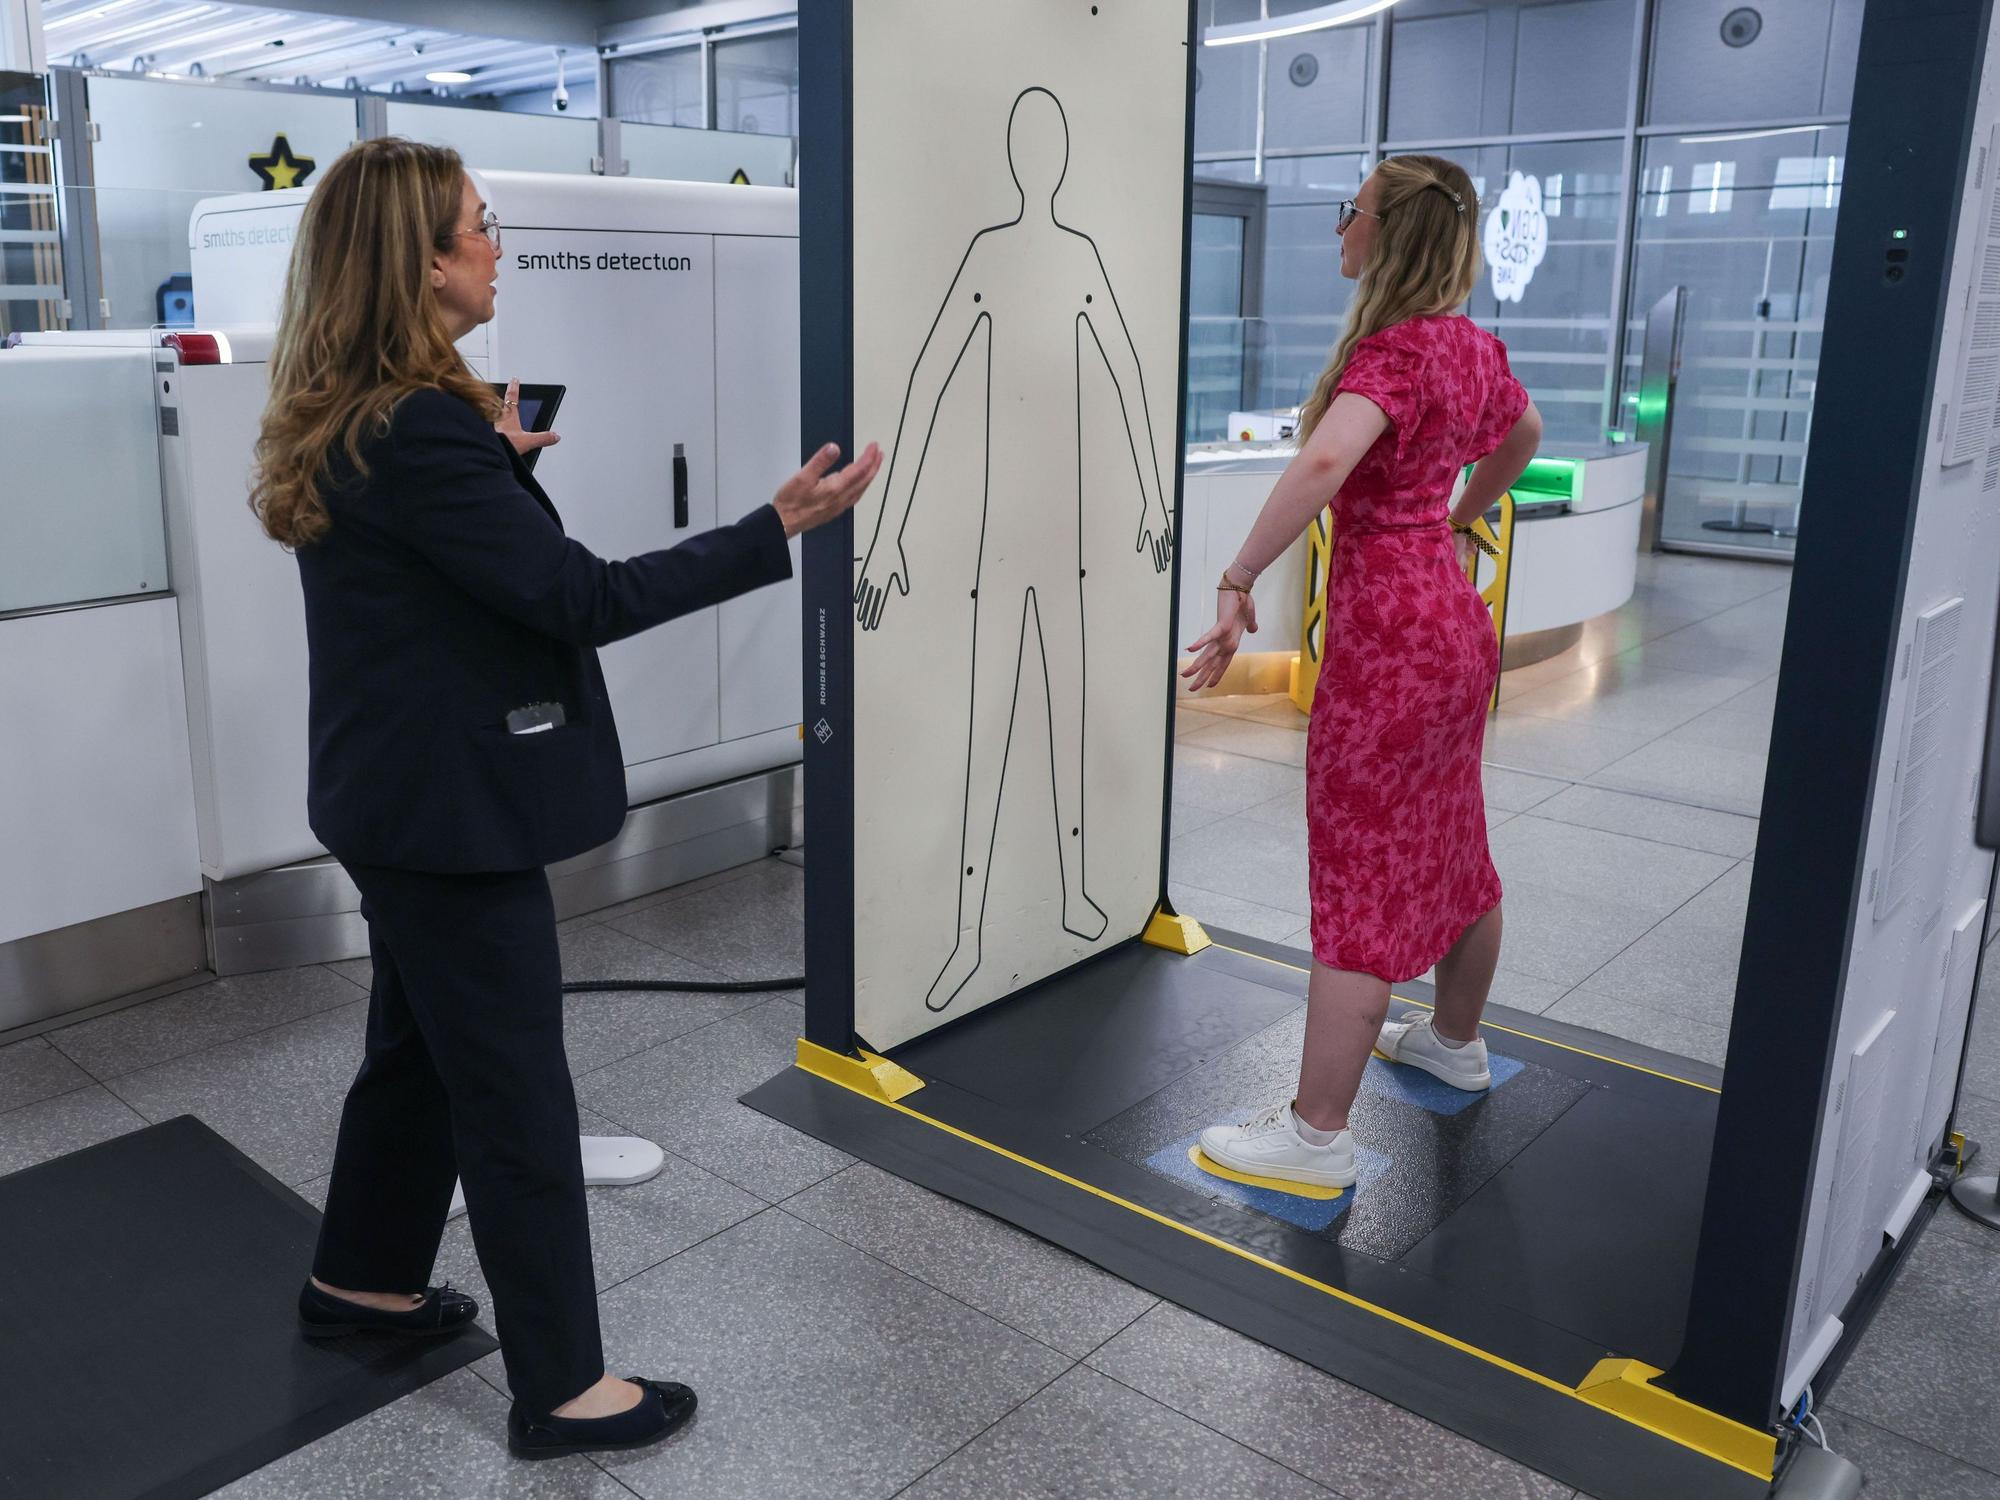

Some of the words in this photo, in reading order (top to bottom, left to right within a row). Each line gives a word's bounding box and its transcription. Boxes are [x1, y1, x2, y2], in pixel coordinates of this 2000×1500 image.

[203, 229, 245, 248] smiths
[248, 224, 293, 245] detect
[517, 251, 591, 270] smiths
[597, 252, 691, 271] detection
[819, 608, 827, 705] ROHDE&SCHWARZ
